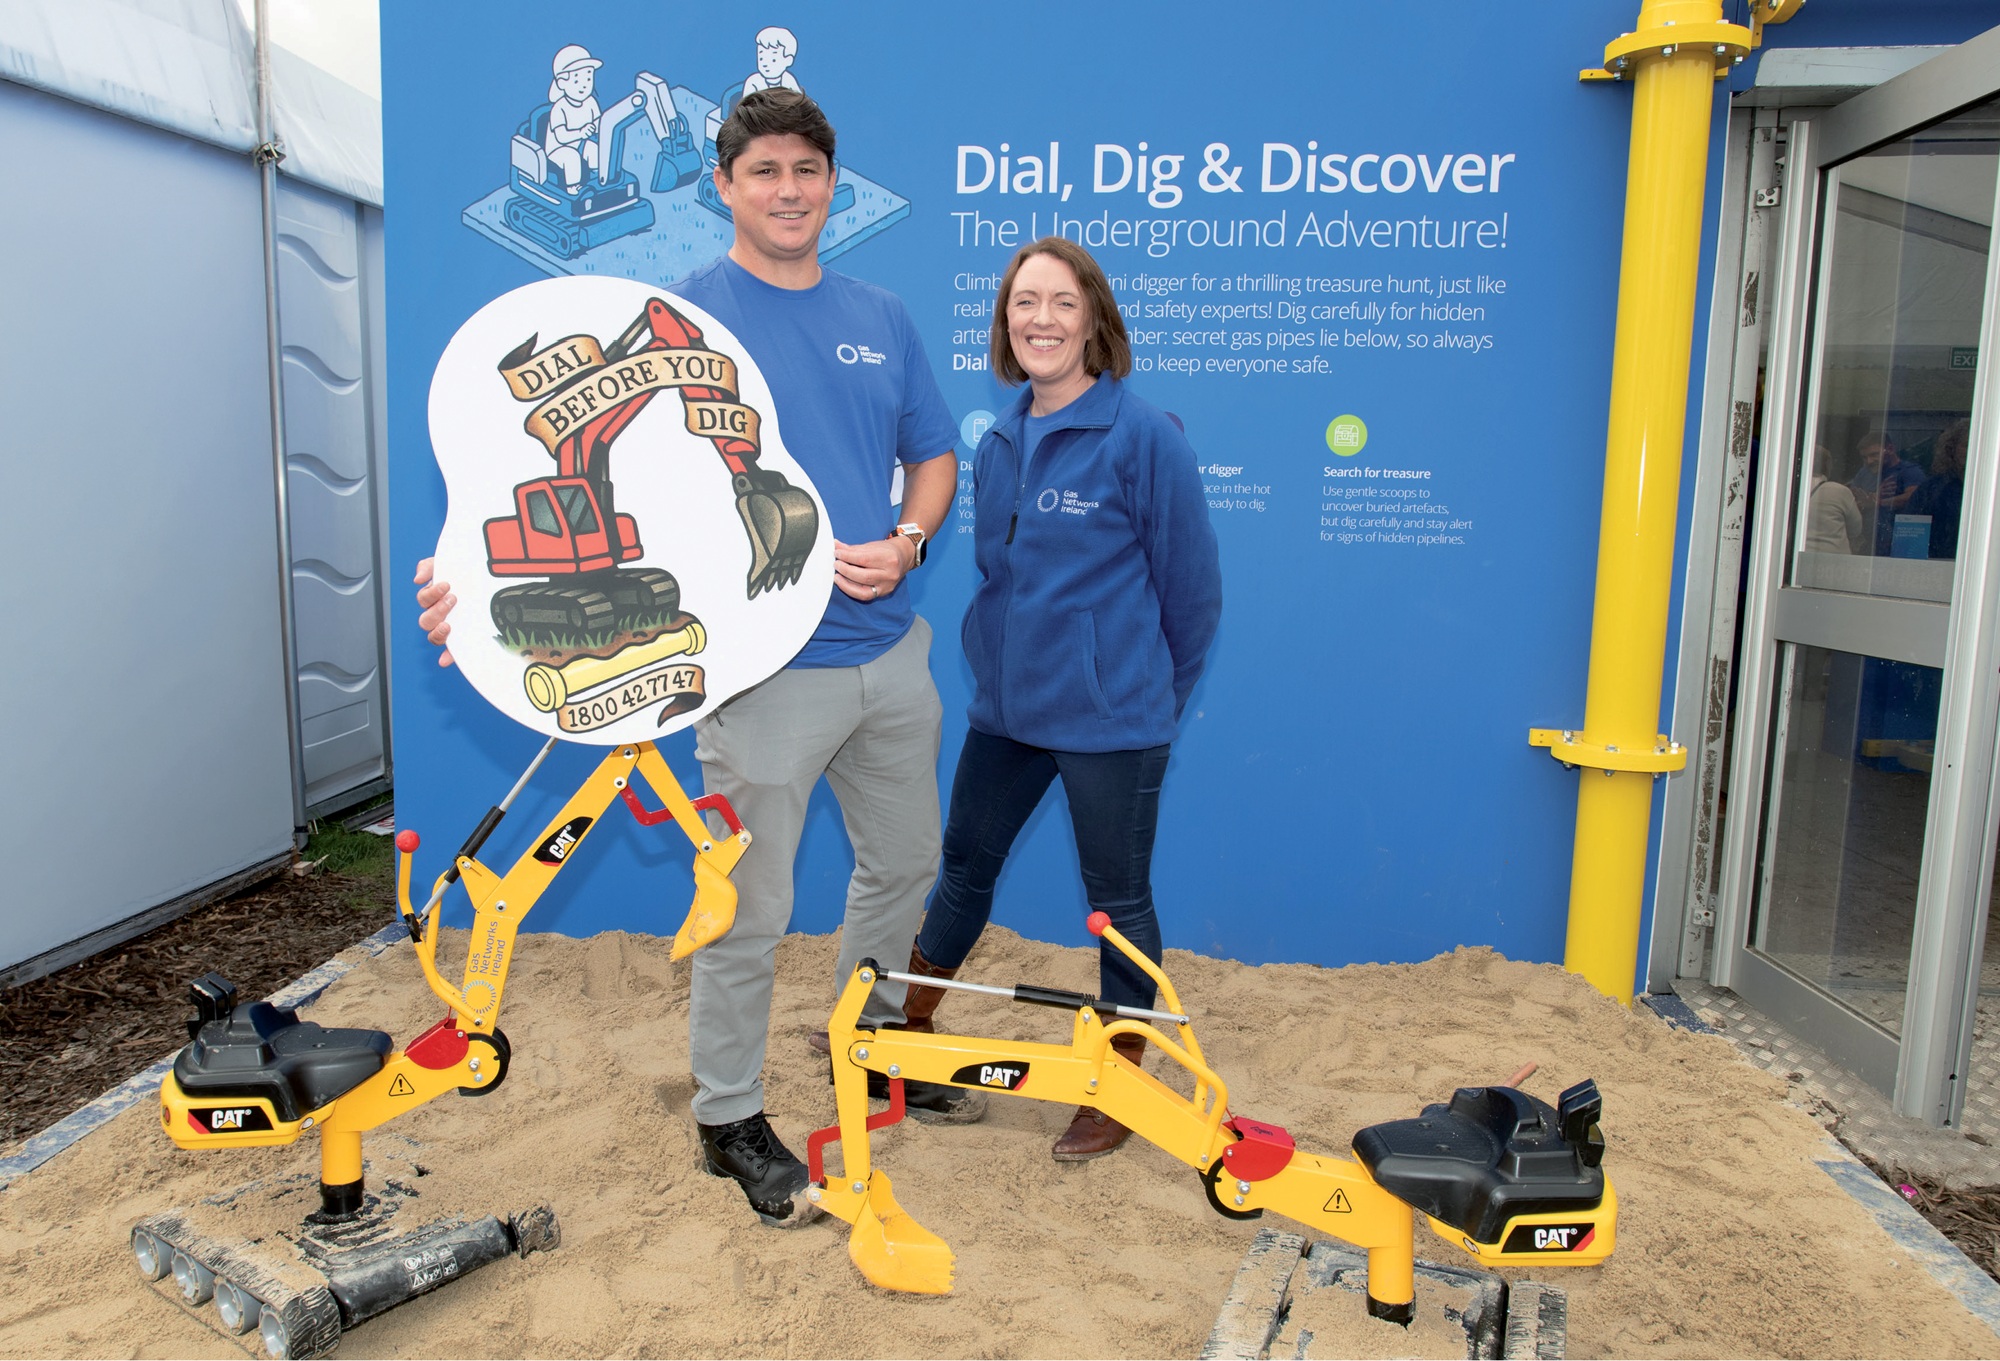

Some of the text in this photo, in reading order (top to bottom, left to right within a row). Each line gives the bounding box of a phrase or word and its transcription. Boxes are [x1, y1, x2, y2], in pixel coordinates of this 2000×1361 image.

[957, 141, 1515, 209] Dial, Dig & Discover
[951, 210, 1508, 259] The Underground Adventure!
[1132, 273, 1187, 296] digger
[1191, 273, 1217, 291] for
[1221, 278, 1231, 291] a
[1236, 273, 1301, 297] thrilling
[1306, 276, 1382, 292] treasure
[1388, 274, 1433, 295] hunt,
[1437, 276, 1472, 298] just
[1477, 275, 1506, 294] like
[1145, 300, 1197, 323] safety
[1201, 302, 1272, 323] experts!
[1278, 302, 1307, 324] Dig
[1311, 301, 1386, 325] carefully
[1390, 302, 1416, 320] for
[1421, 302, 1484, 321] hidden
[1172, 330, 1227, 345] secret
[1231, 332, 1261, 350] gas
[1267, 329, 1315, 351] pipes
[1320, 328, 1339, 346] lie
[1344, 329, 1401, 350] below,
[1407, 334, 1428, 348] so
[1433, 330, 1493, 353] always
[517, 344, 593, 396] DIAL
[953, 353, 1332, 377] Dial to keep everyone safe.
[1953, 355, 1978, 367] EXI
[542, 355, 726, 438] BEFORE YOU
[697, 406, 750, 435] DIG
[1209, 464, 1243, 477] digger
[1324, 467, 1431, 479] Search for treasure
[960, 479, 966, 489] If
[1063, 490, 1079, 498] Gas
[1222, 483, 1232, 494] in
[1234, 483, 1251, 494] the
[1254, 484, 1271, 494] hot
[1323, 486, 1430, 500] Use gentle scoops to
[1236, 500, 1247, 509] to
[1249, 499, 1266, 512] dig.
[1322, 502, 1449, 515] uncover buried artefacts,
[1321, 516, 1472, 532] but dig carefully and stay alert
[1321, 530, 1465, 546] for signs of hidden pipelines.
[568, 697, 618, 728] 1800
[549, 829, 577, 859] CAT
[479, 921, 498, 974] Networks
[490, 939, 506, 976] Ireland
[469, 953, 481, 973] Gas
[980, 1065, 1014, 1088] CAT
[211, 1109, 245, 1129] CAT
[1534, 1228, 1570, 1249] CAT
